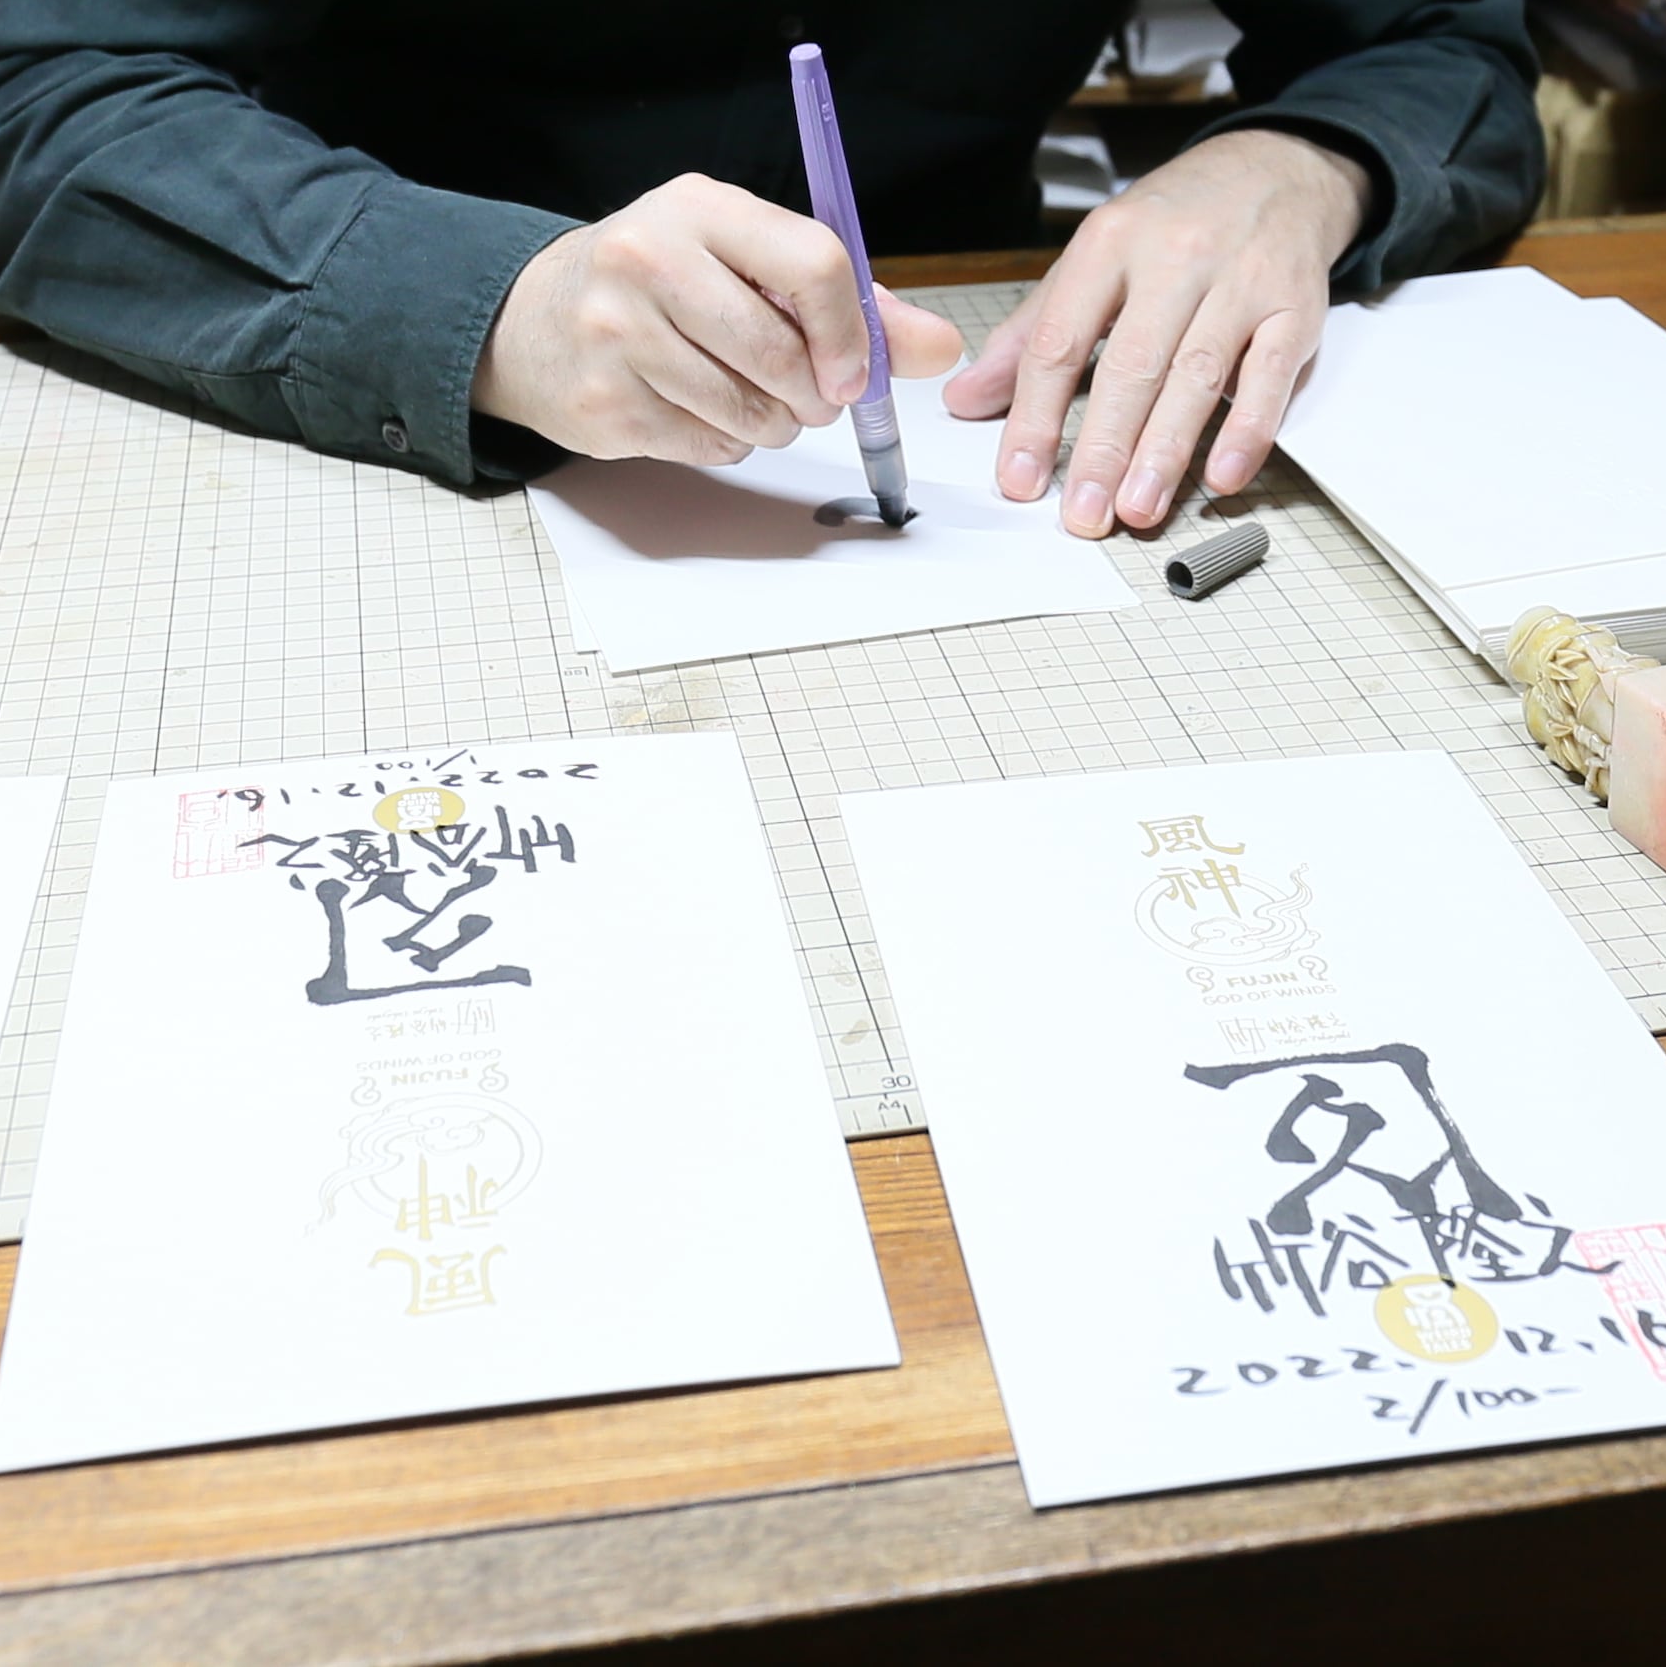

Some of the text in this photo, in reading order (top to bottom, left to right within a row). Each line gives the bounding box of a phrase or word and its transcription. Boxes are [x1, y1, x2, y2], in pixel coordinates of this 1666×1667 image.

[1136, 814, 1246, 918] 風神
[1226, 971, 1299, 988] FUJIN
[1202, 982, 1339, 1007] GOD OF WINDS
[355, 1048, 503, 1073] GOD OF WINDS
[389, 1067, 471, 1086] FUJIN
[880, 1074, 912, 1089] 30
[877, 1099, 902, 1111] A4
